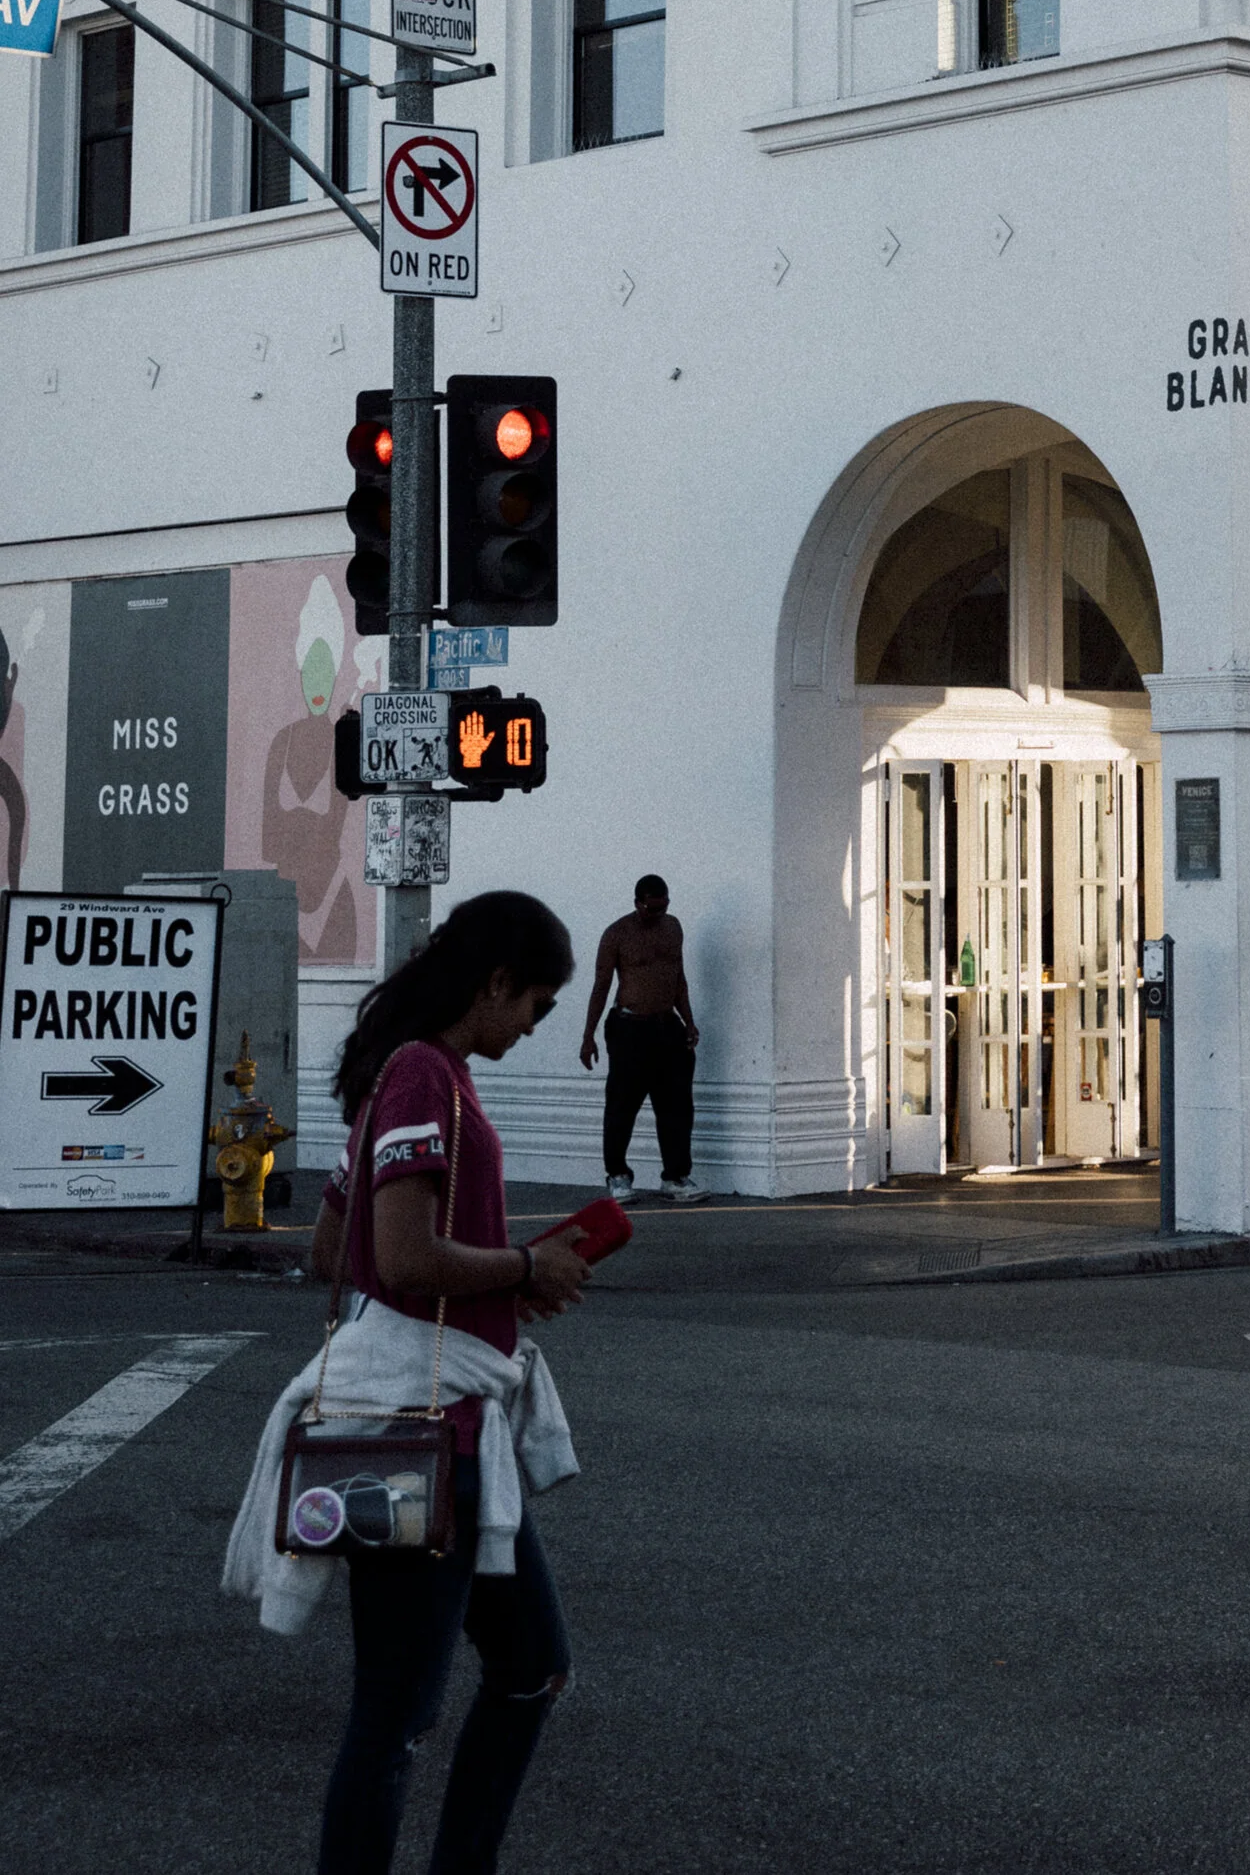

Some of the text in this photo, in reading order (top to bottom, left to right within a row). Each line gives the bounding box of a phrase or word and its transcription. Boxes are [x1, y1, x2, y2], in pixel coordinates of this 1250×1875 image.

[396, 10, 472, 41] INTERSECTION
[390, 249, 470, 281] ON RED
[435, 632, 481, 659] Pacific
[374, 695, 436, 710] DIAGONAL
[374, 710, 437, 725] CROSSING
[113, 716, 178, 750] MISS
[506, 717, 532, 766] 10
[367, 739, 399, 772] OK
[98, 781, 190, 816] GRASS
[60, 903, 165, 913] 29 Windward Ave
[24, 915, 194, 968] PUBLIC
[12, 989, 197, 1040] PARKING
